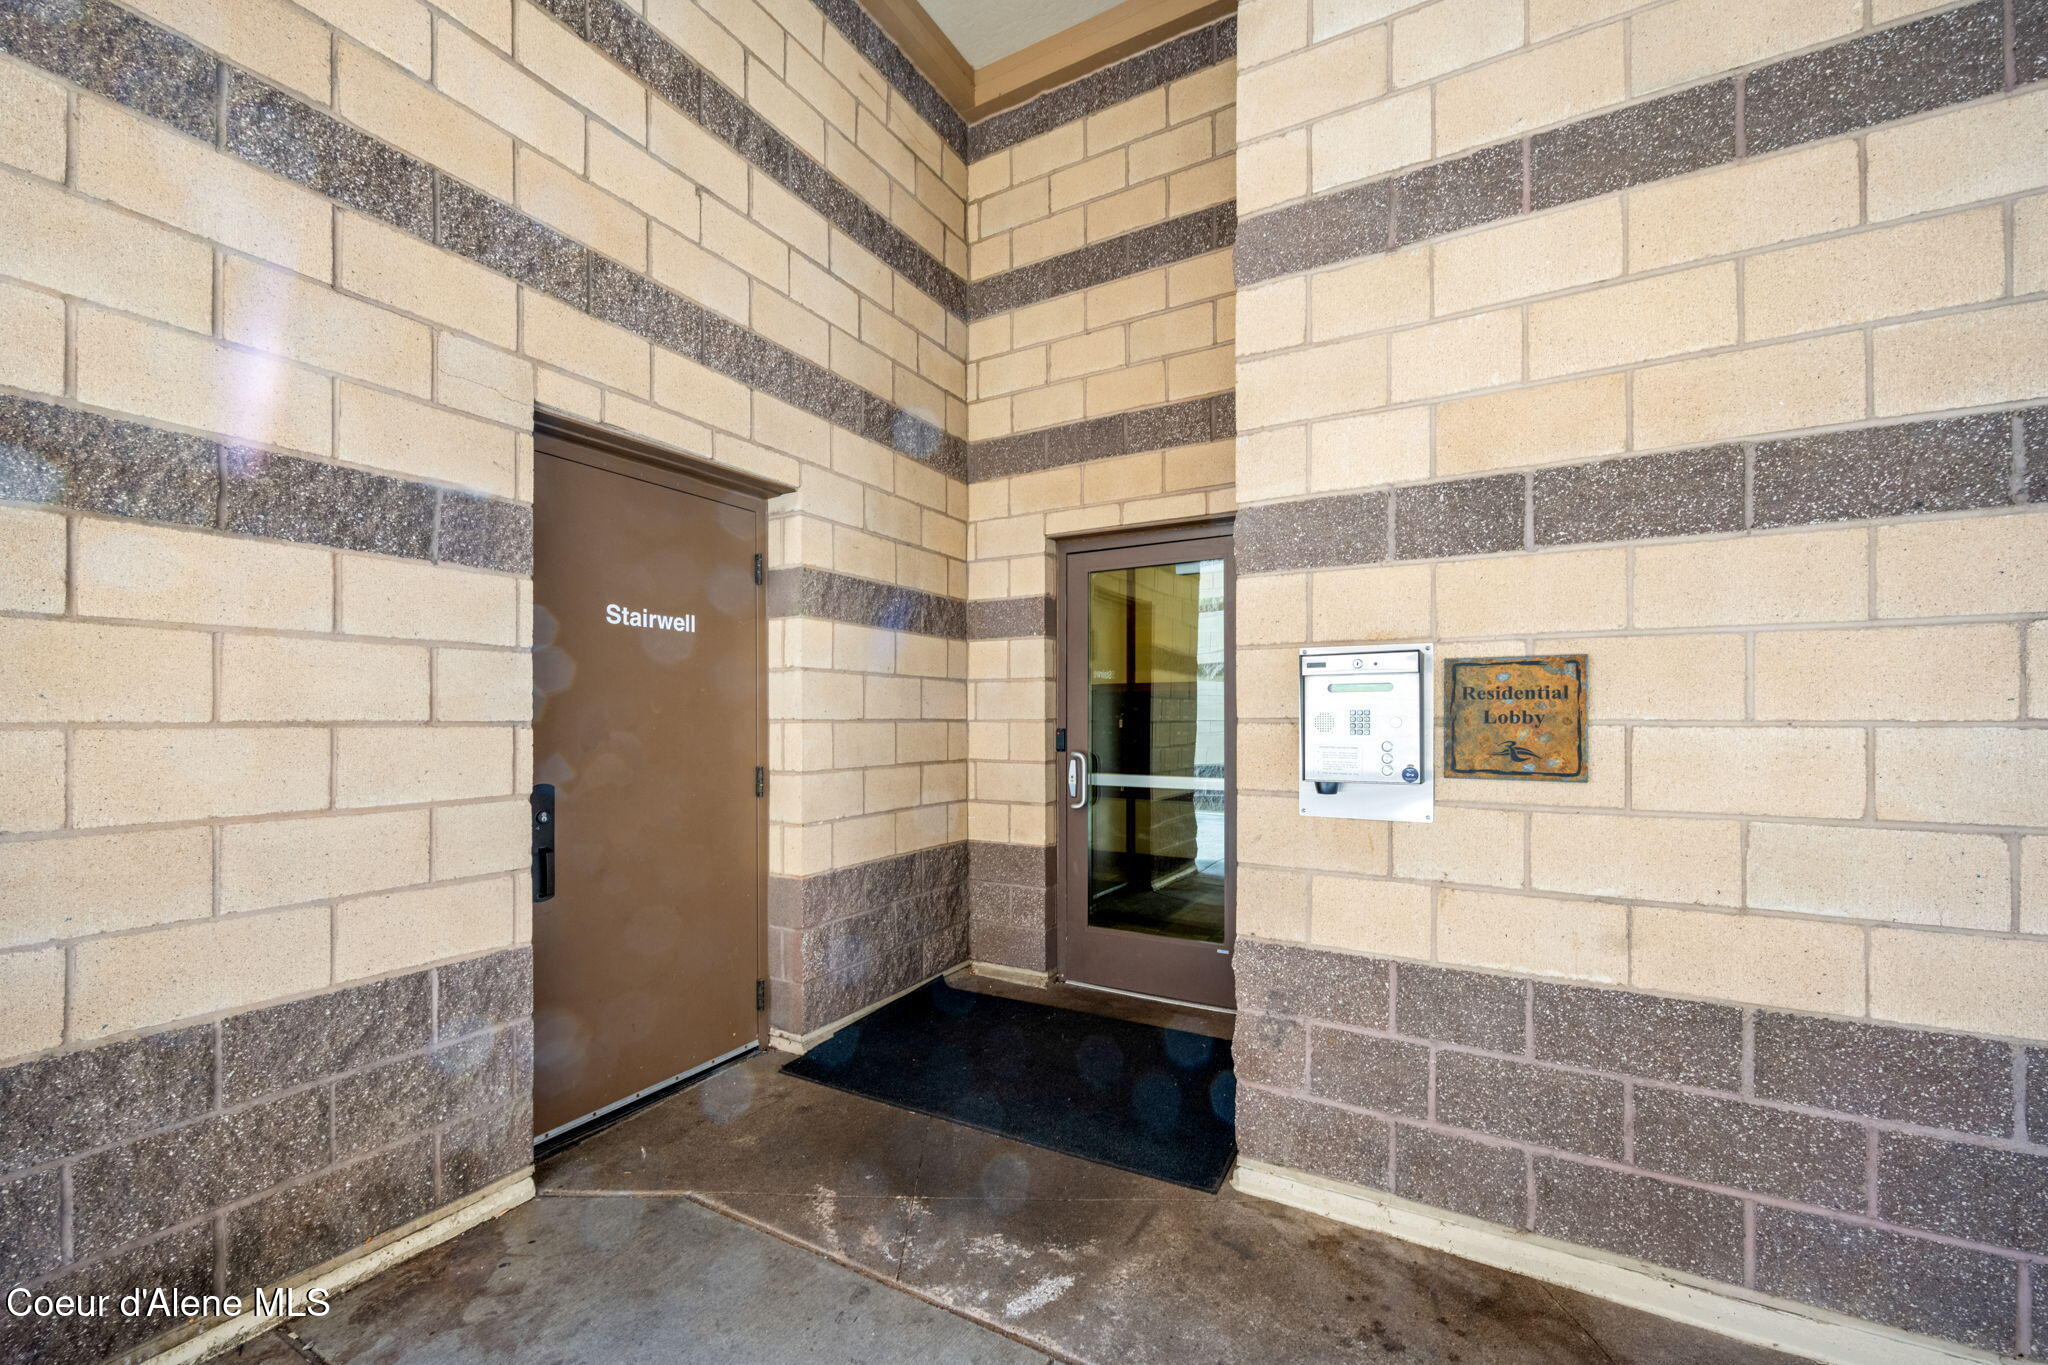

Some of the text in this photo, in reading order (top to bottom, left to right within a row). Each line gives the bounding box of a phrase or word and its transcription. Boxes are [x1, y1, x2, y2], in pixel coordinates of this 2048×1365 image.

[605, 603, 696, 633] Stairwell
[1461, 684, 1569, 700] Residential
[1483, 709, 1546, 729] Lobby
